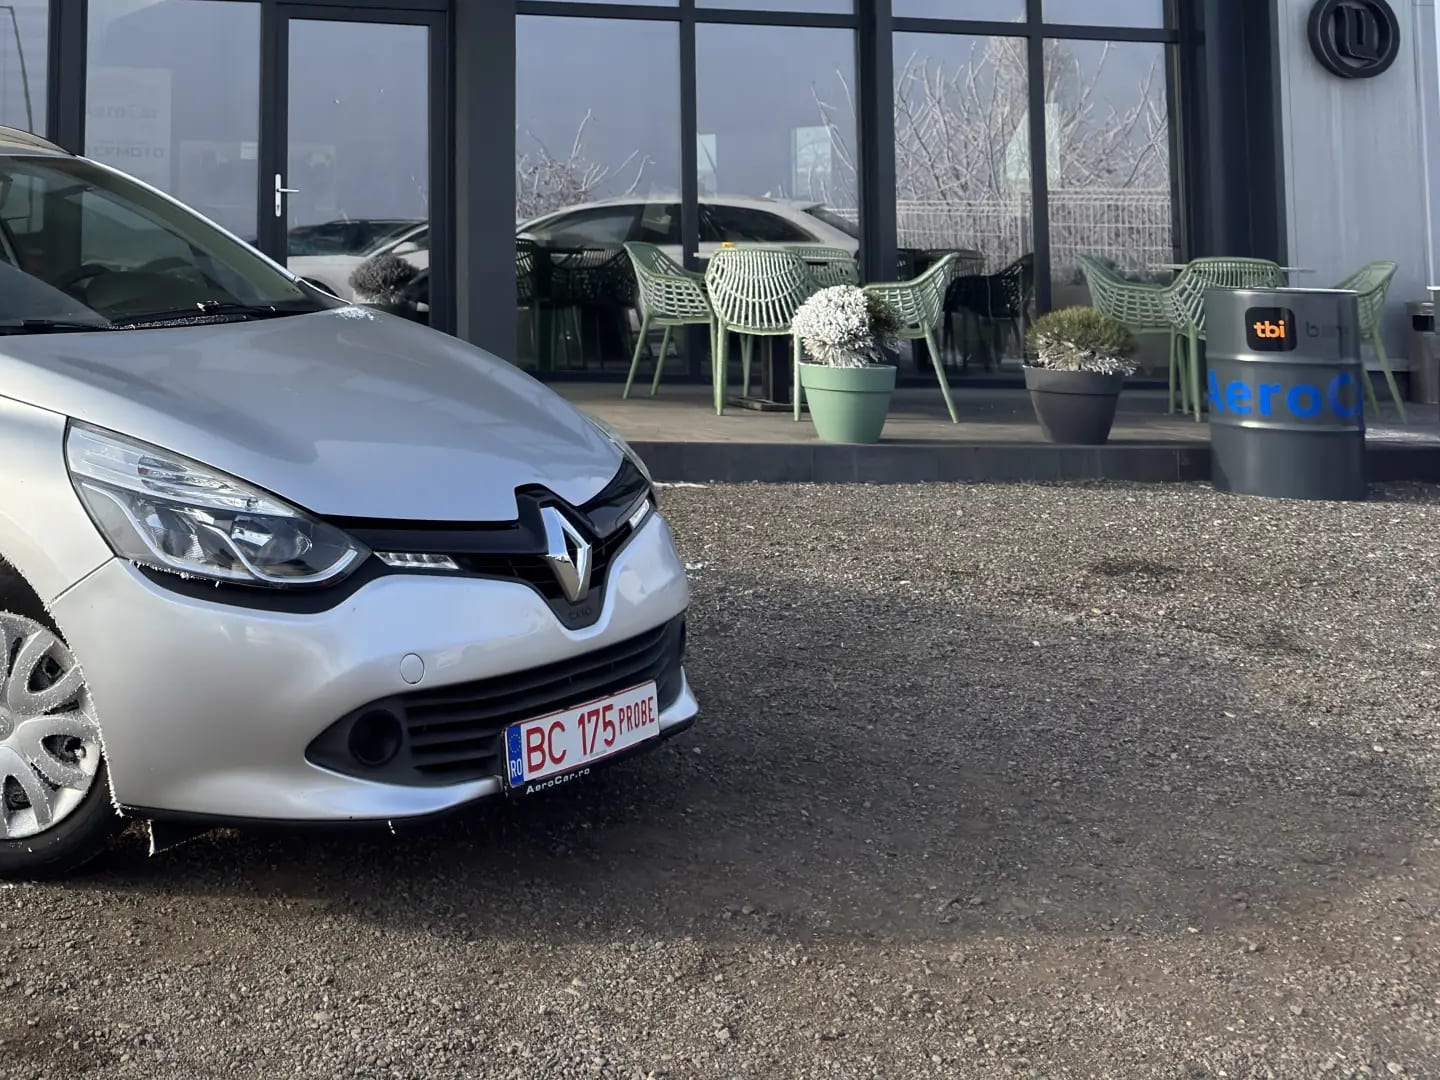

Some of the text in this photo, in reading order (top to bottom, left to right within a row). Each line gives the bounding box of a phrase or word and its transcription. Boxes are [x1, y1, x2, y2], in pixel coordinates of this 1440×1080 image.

[1253, 320, 1286, 338] tbi
[1207, 368, 1364, 418] AeroC
[526, 696, 655, 773] BC 175 PROBE
[510, 758, 523, 778] RO
[526, 768, 590, 795] AeroCar.ro
